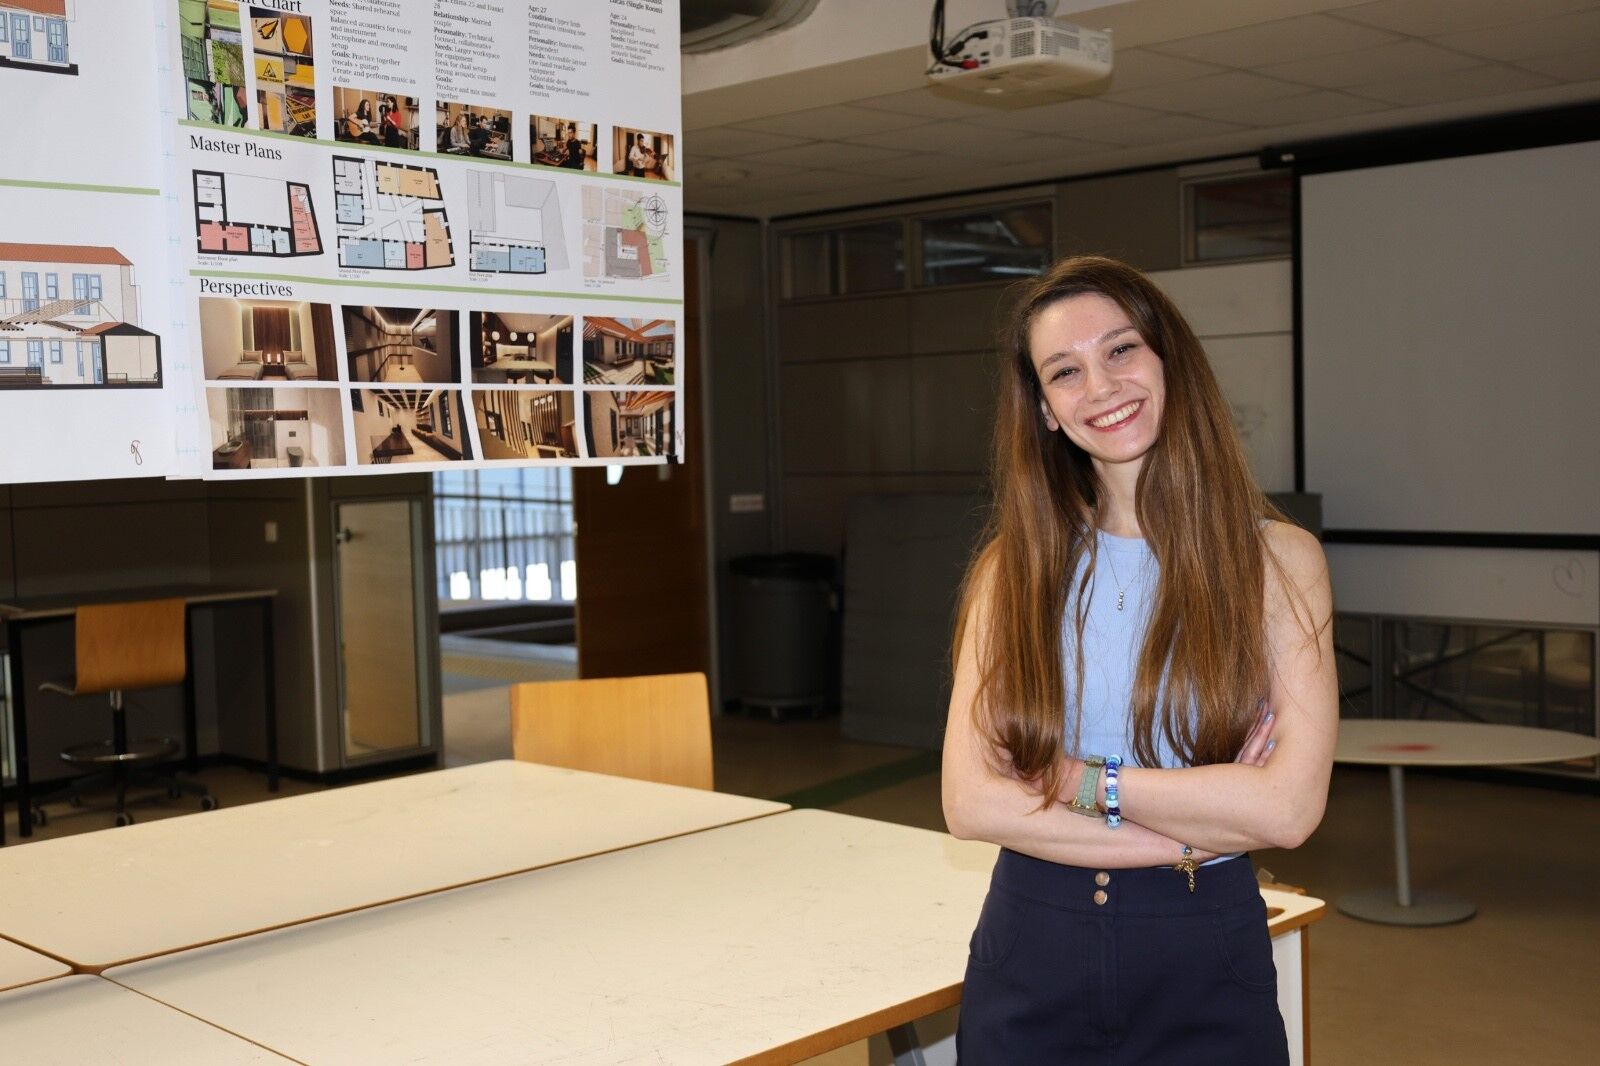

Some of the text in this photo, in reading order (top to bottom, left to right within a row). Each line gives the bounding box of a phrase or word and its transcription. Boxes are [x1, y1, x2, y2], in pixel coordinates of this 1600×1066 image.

[262, 0, 302, 12] Chart
[329, 0, 400, 16] Needs: Shared rehearsal
[330, 16, 357, 26] Balanced
[359, 21, 385, 30] acoustics
[471, 18, 491, 26] Married
[344, 27, 376, 37] instrument
[434, 27, 466, 37] Personality:
[331, 33, 366, 44] Microphone
[380, 41, 408, 51] recording
[332, 50, 400, 66] Goals: Practice together
[332, 59, 352, 67] (vocals
[332, 67, 351, 75] Create
[354, 69, 364, 77] and
[366, 72, 389, 80] perform
[436, 84, 457, 92] Produce
[190, 134, 282, 160] Master Plans
[200, 278, 293, 297] Perspectives
